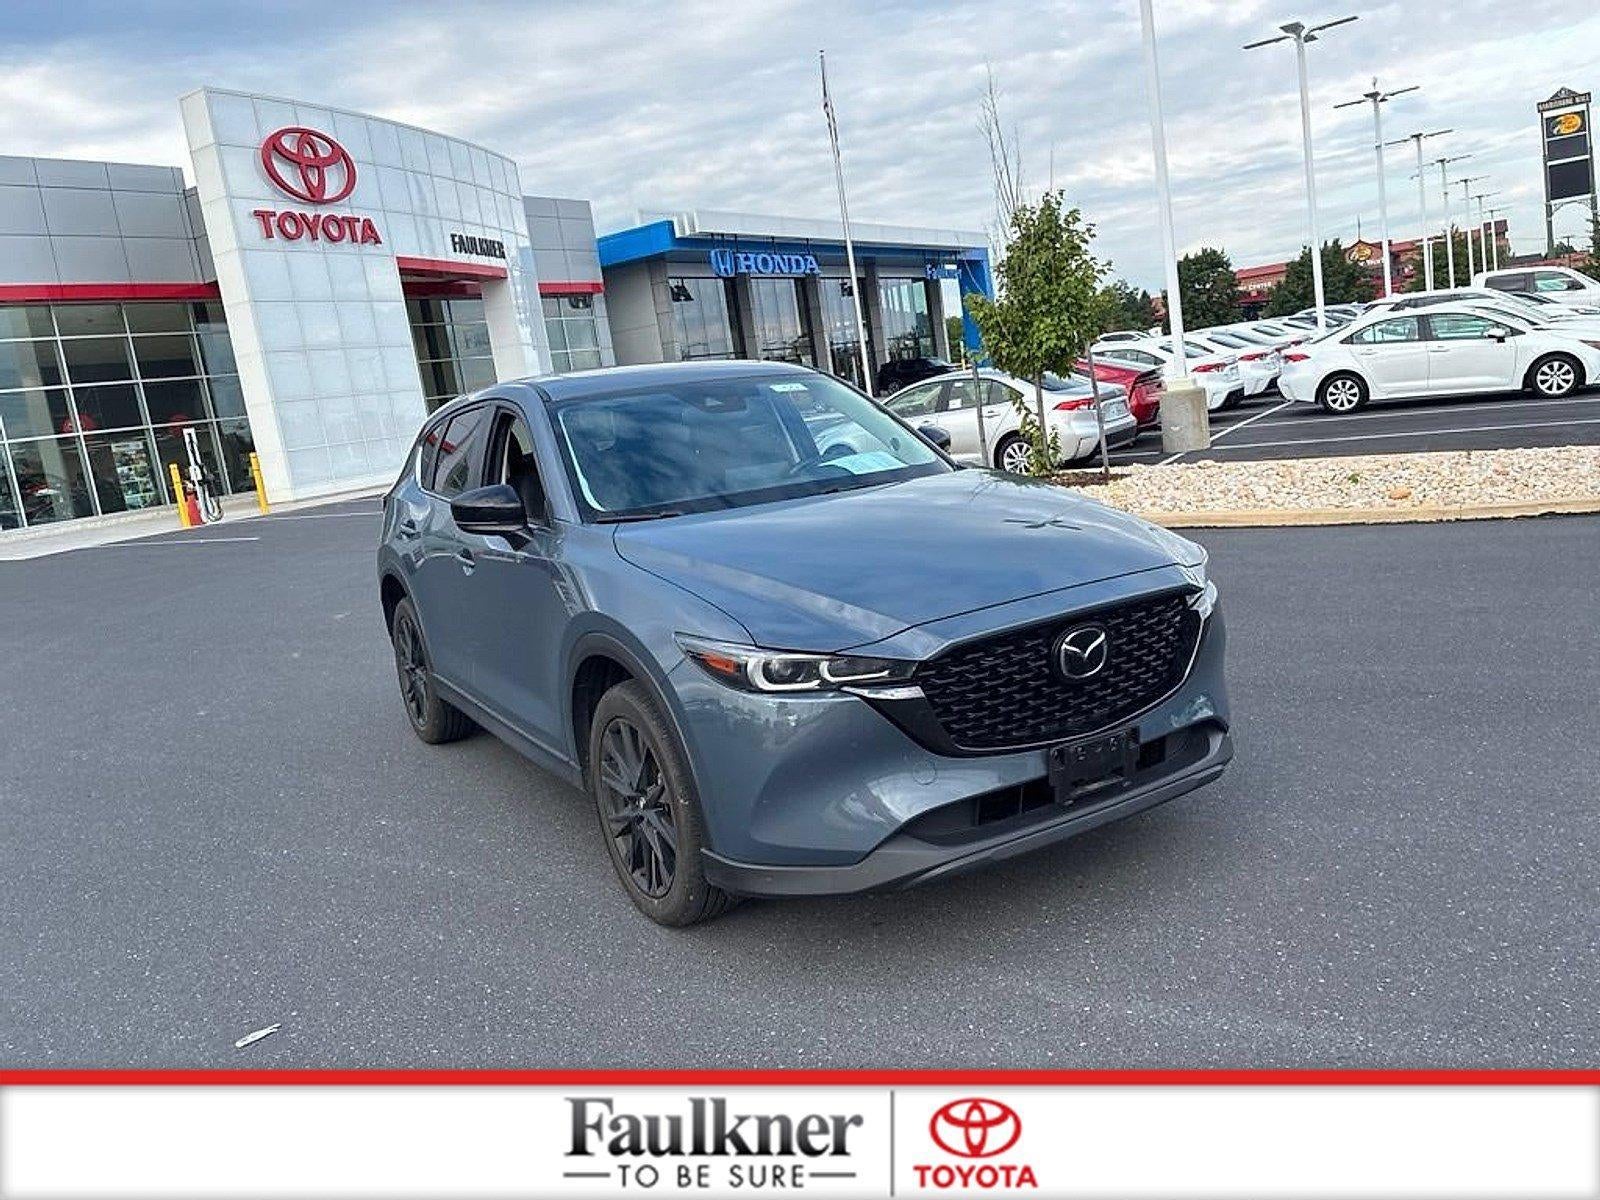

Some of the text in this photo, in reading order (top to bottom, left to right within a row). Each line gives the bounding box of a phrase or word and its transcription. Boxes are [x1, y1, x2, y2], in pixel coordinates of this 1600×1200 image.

[253, 209, 382, 245] TOYOTA
[450, 233, 506, 259] FAULKNER
[736, 252, 821, 275] HONDA
